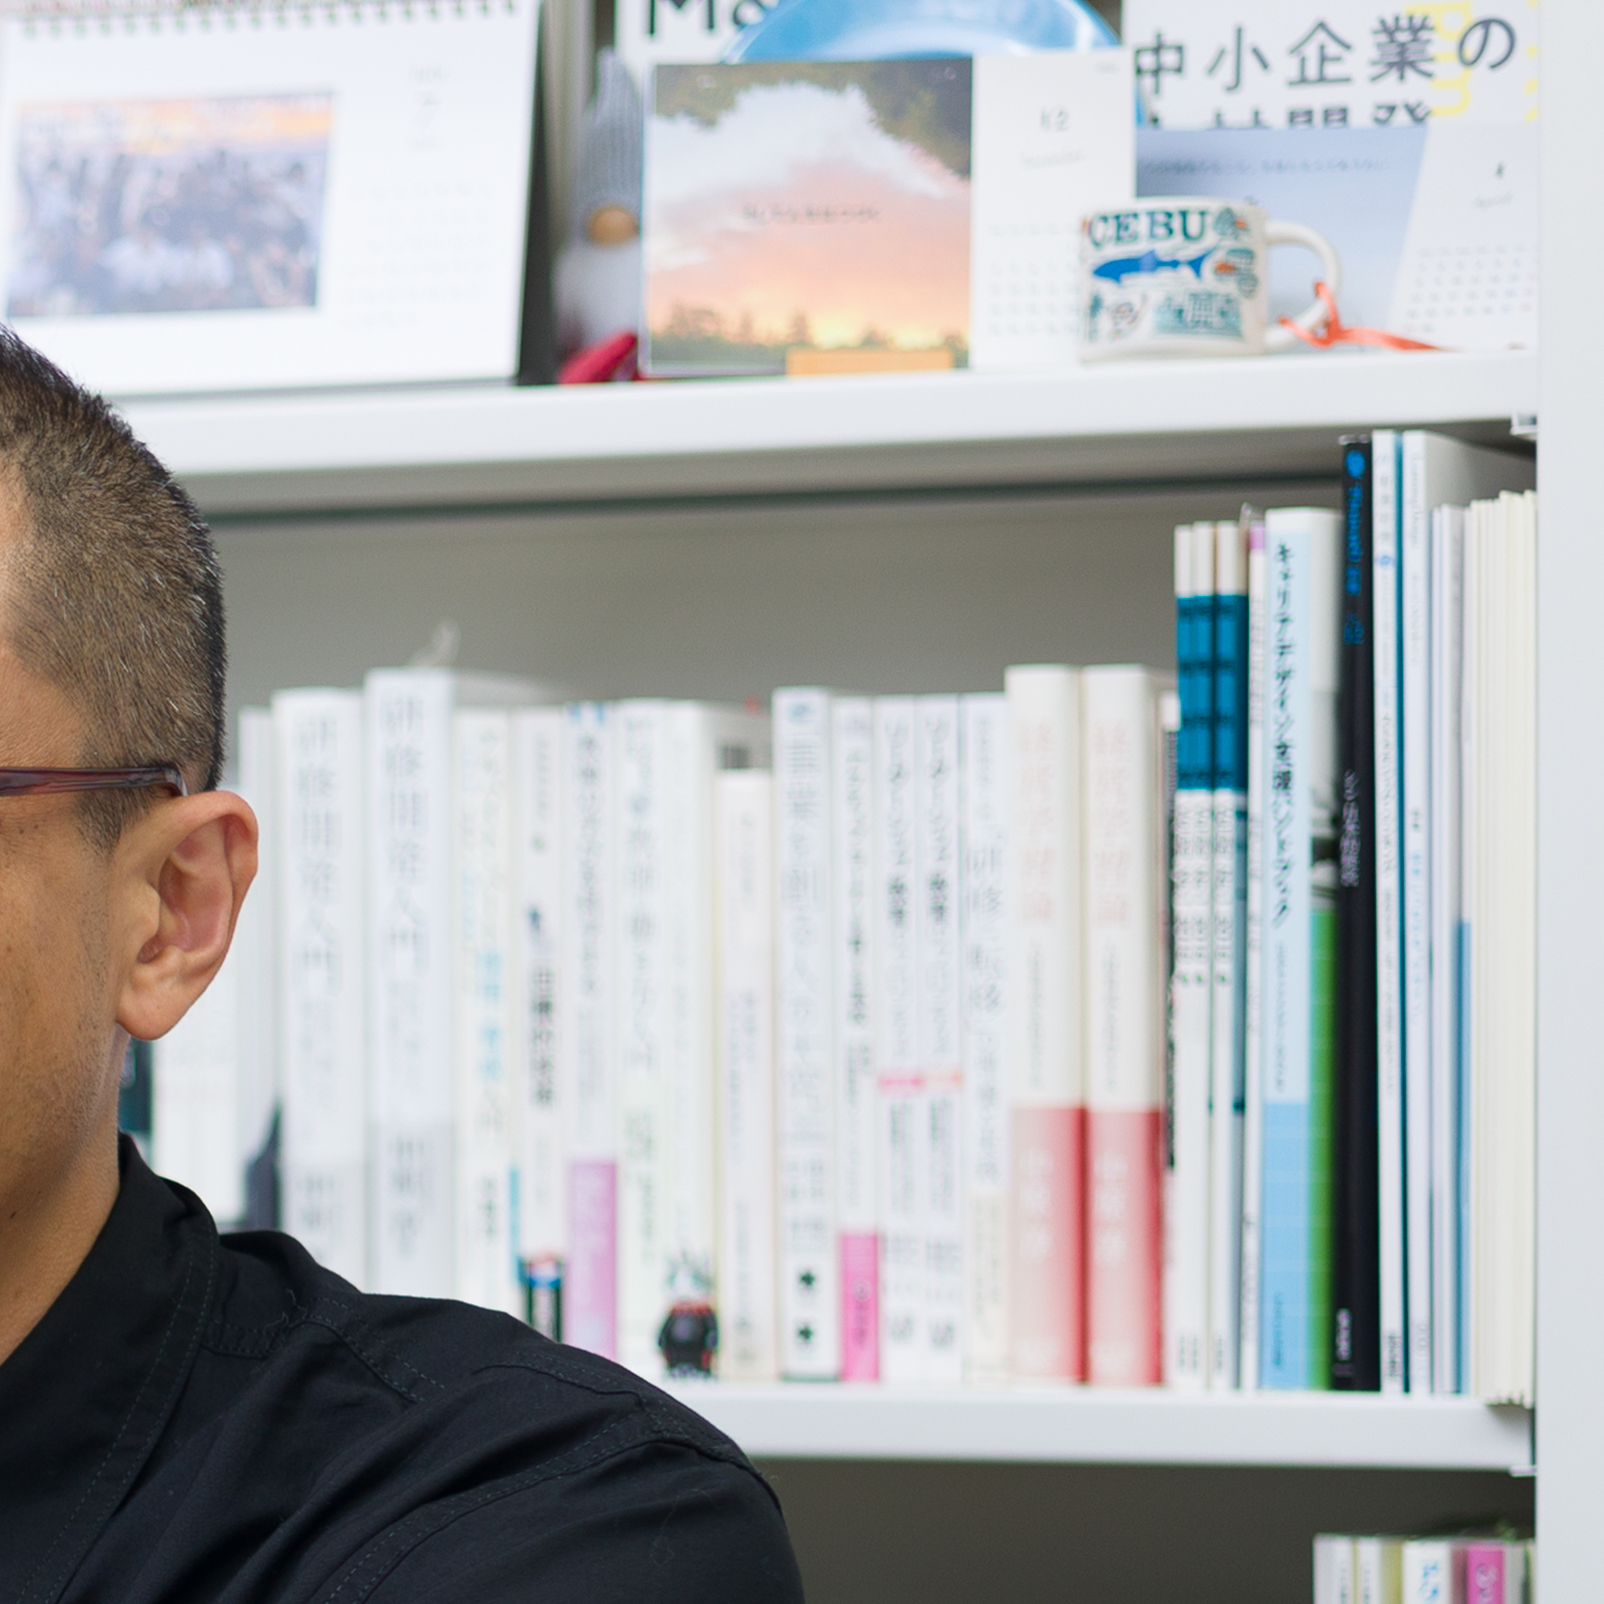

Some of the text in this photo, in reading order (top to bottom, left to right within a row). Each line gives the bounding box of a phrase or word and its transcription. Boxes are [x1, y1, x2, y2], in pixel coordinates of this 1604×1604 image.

[1133, 16, 1518, 96] 中小企業の
[1088, 208, 1212, 250] CEBU
[383, 693, 426, 972] 研修開発入門
